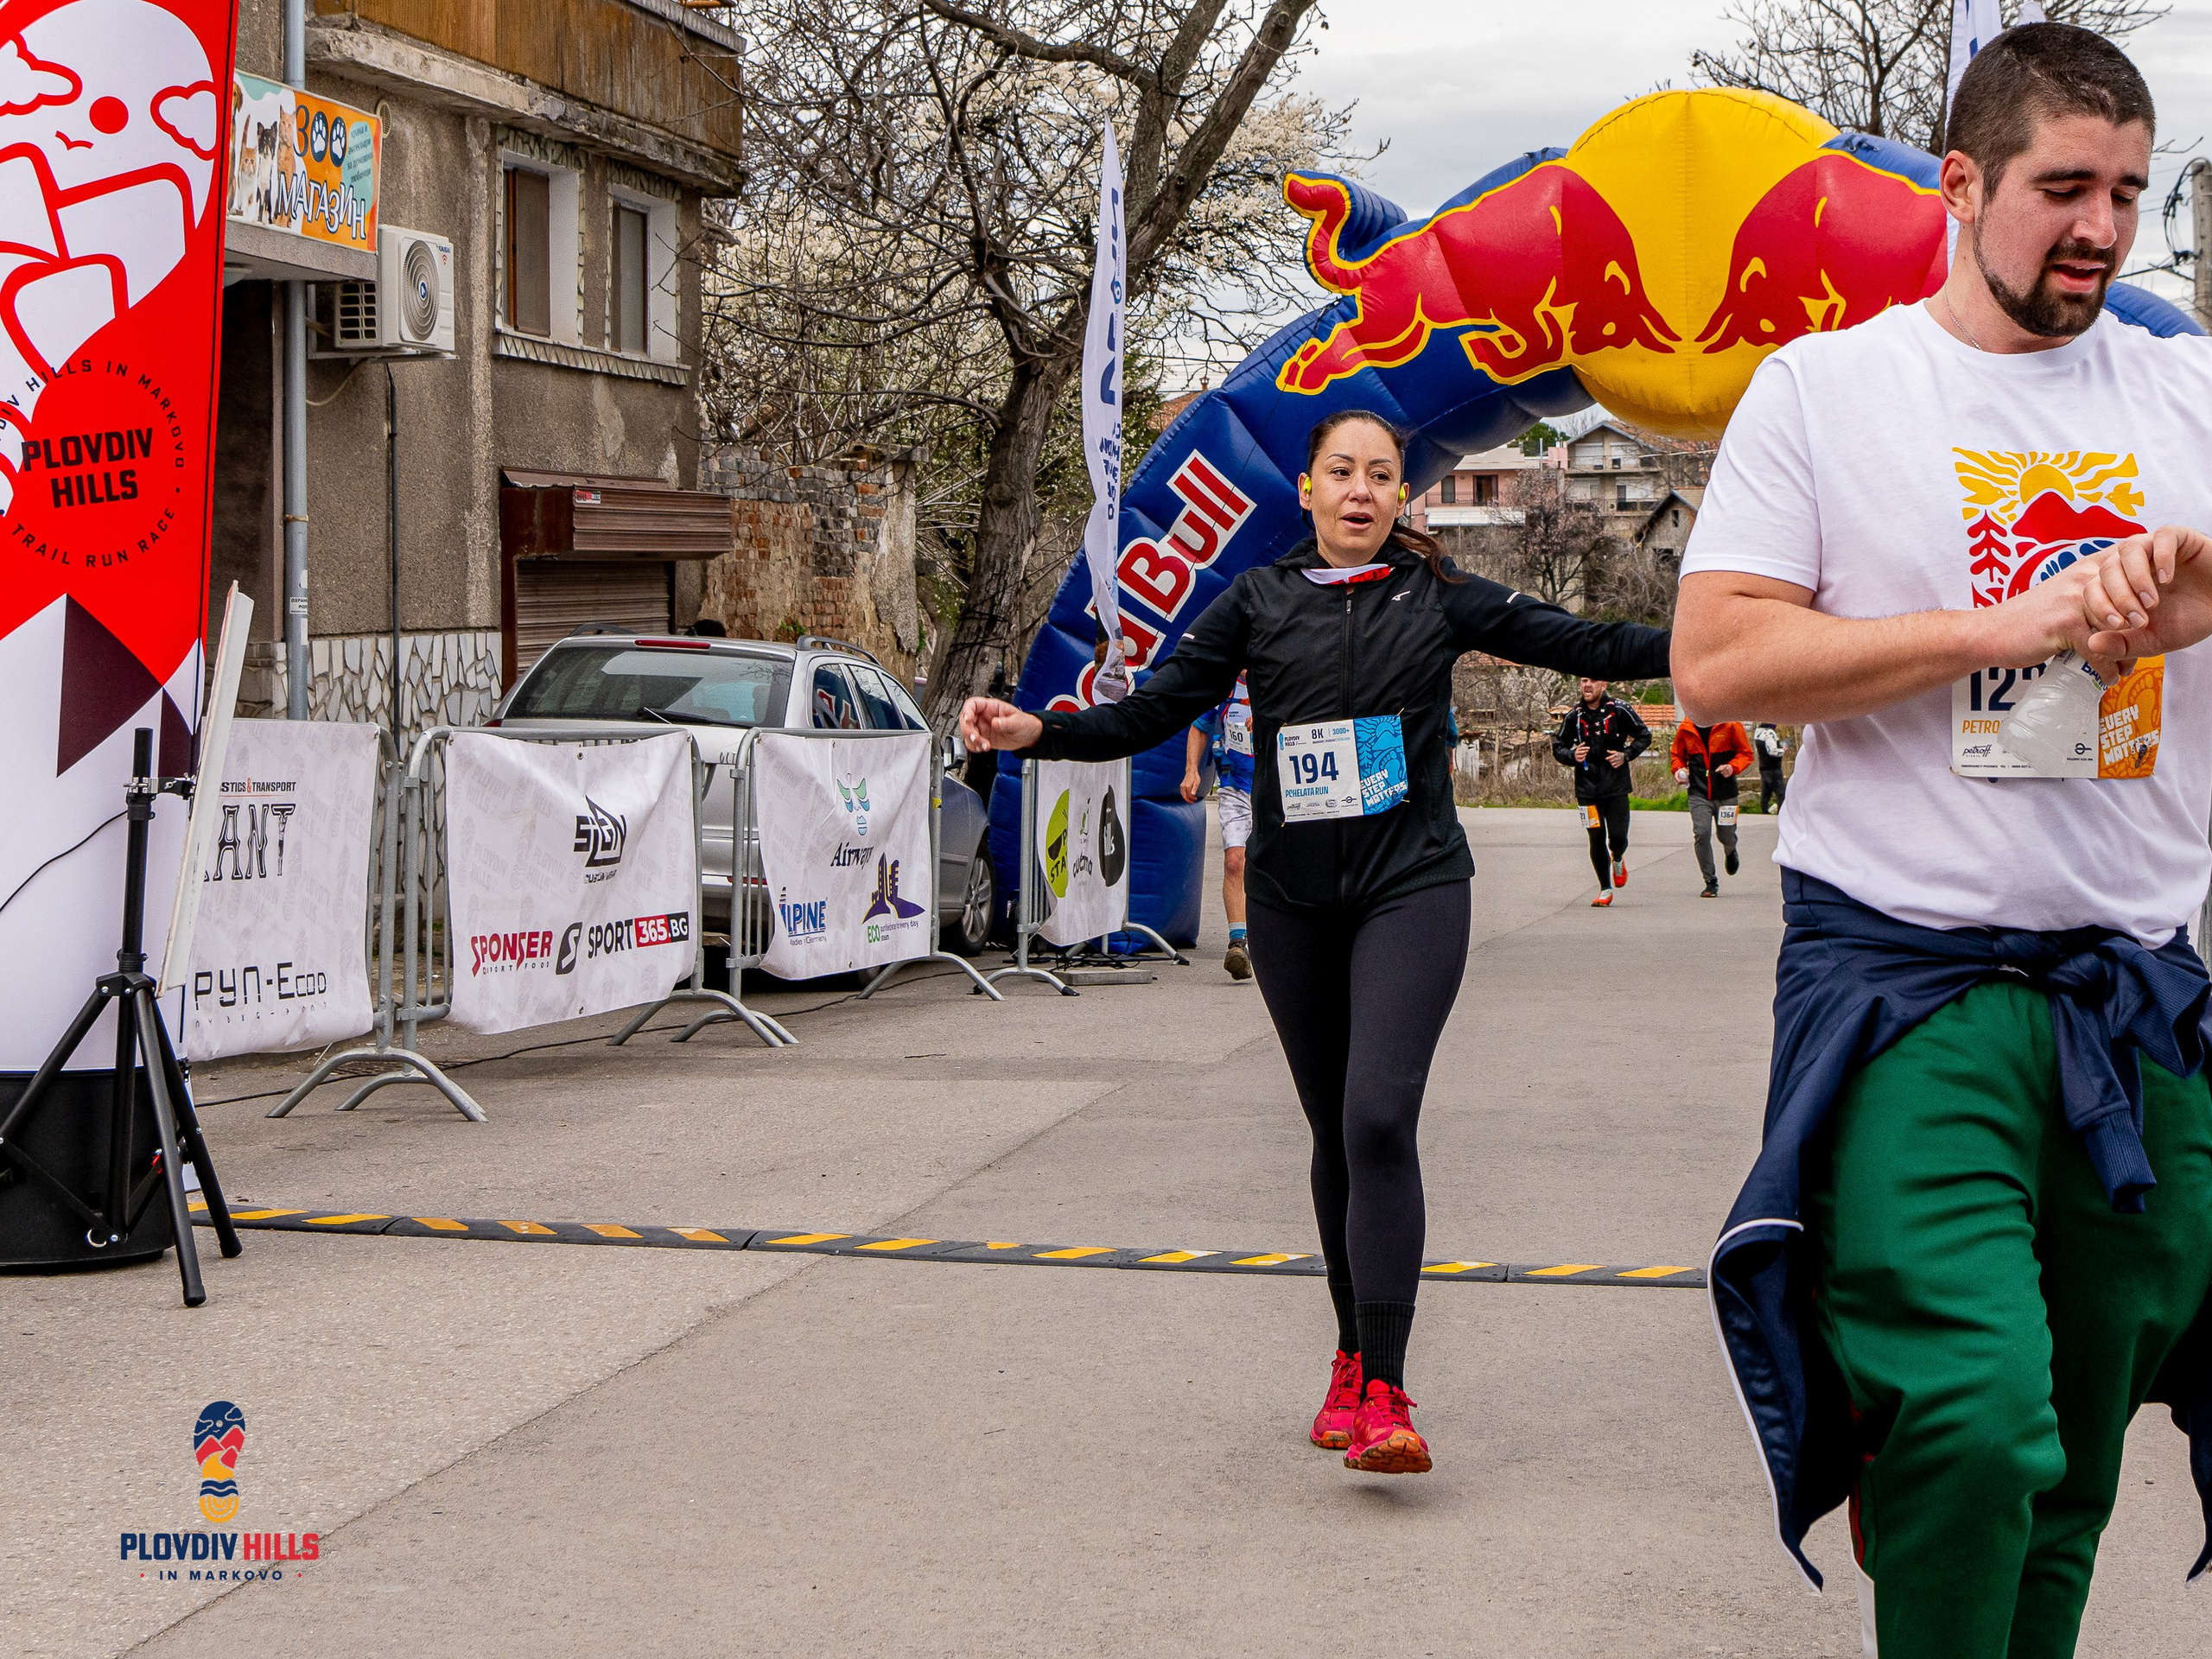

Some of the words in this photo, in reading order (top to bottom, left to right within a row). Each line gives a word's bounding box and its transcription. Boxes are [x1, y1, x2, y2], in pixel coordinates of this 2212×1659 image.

[276, 170, 366, 240] МАГАЗИН
[25, 359, 92, 392] HILLS
[106, 360, 128, 377] IN
[137, 373, 184, 468] MARKOVO
[22, 427, 153, 473] PLOVDIV
[50, 469, 139, 509] HILLS
[12, 523, 71, 565] TRAIL
[86, 550, 129, 569] RUN
[137, 507, 175, 554] RACE
[1116, 453, 1253, 619] Bull
[1311, 728, 1325, 740] 8K
[1961, 719, 2002, 734] PETRO
[2099, 703, 2139, 734] EVERY
[1229, 729, 1243, 743] 160
[2100, 723, 2133, 750] STEP
[1288, 751, 1339, 785] 194
[1360, 768, 1389, 790] EVERY
[1285, 788, 1314, 798] PCHELATA
[1314, 785, 1329, 795] RUN
[1361, 781, 1386, 798] STEP
[204, 803, 296, 883] ANT
[867, 924, 880, 944] ECO
[471, 930, 553, 978] SPONSER
[524, 961, 550, 969] FOOD
